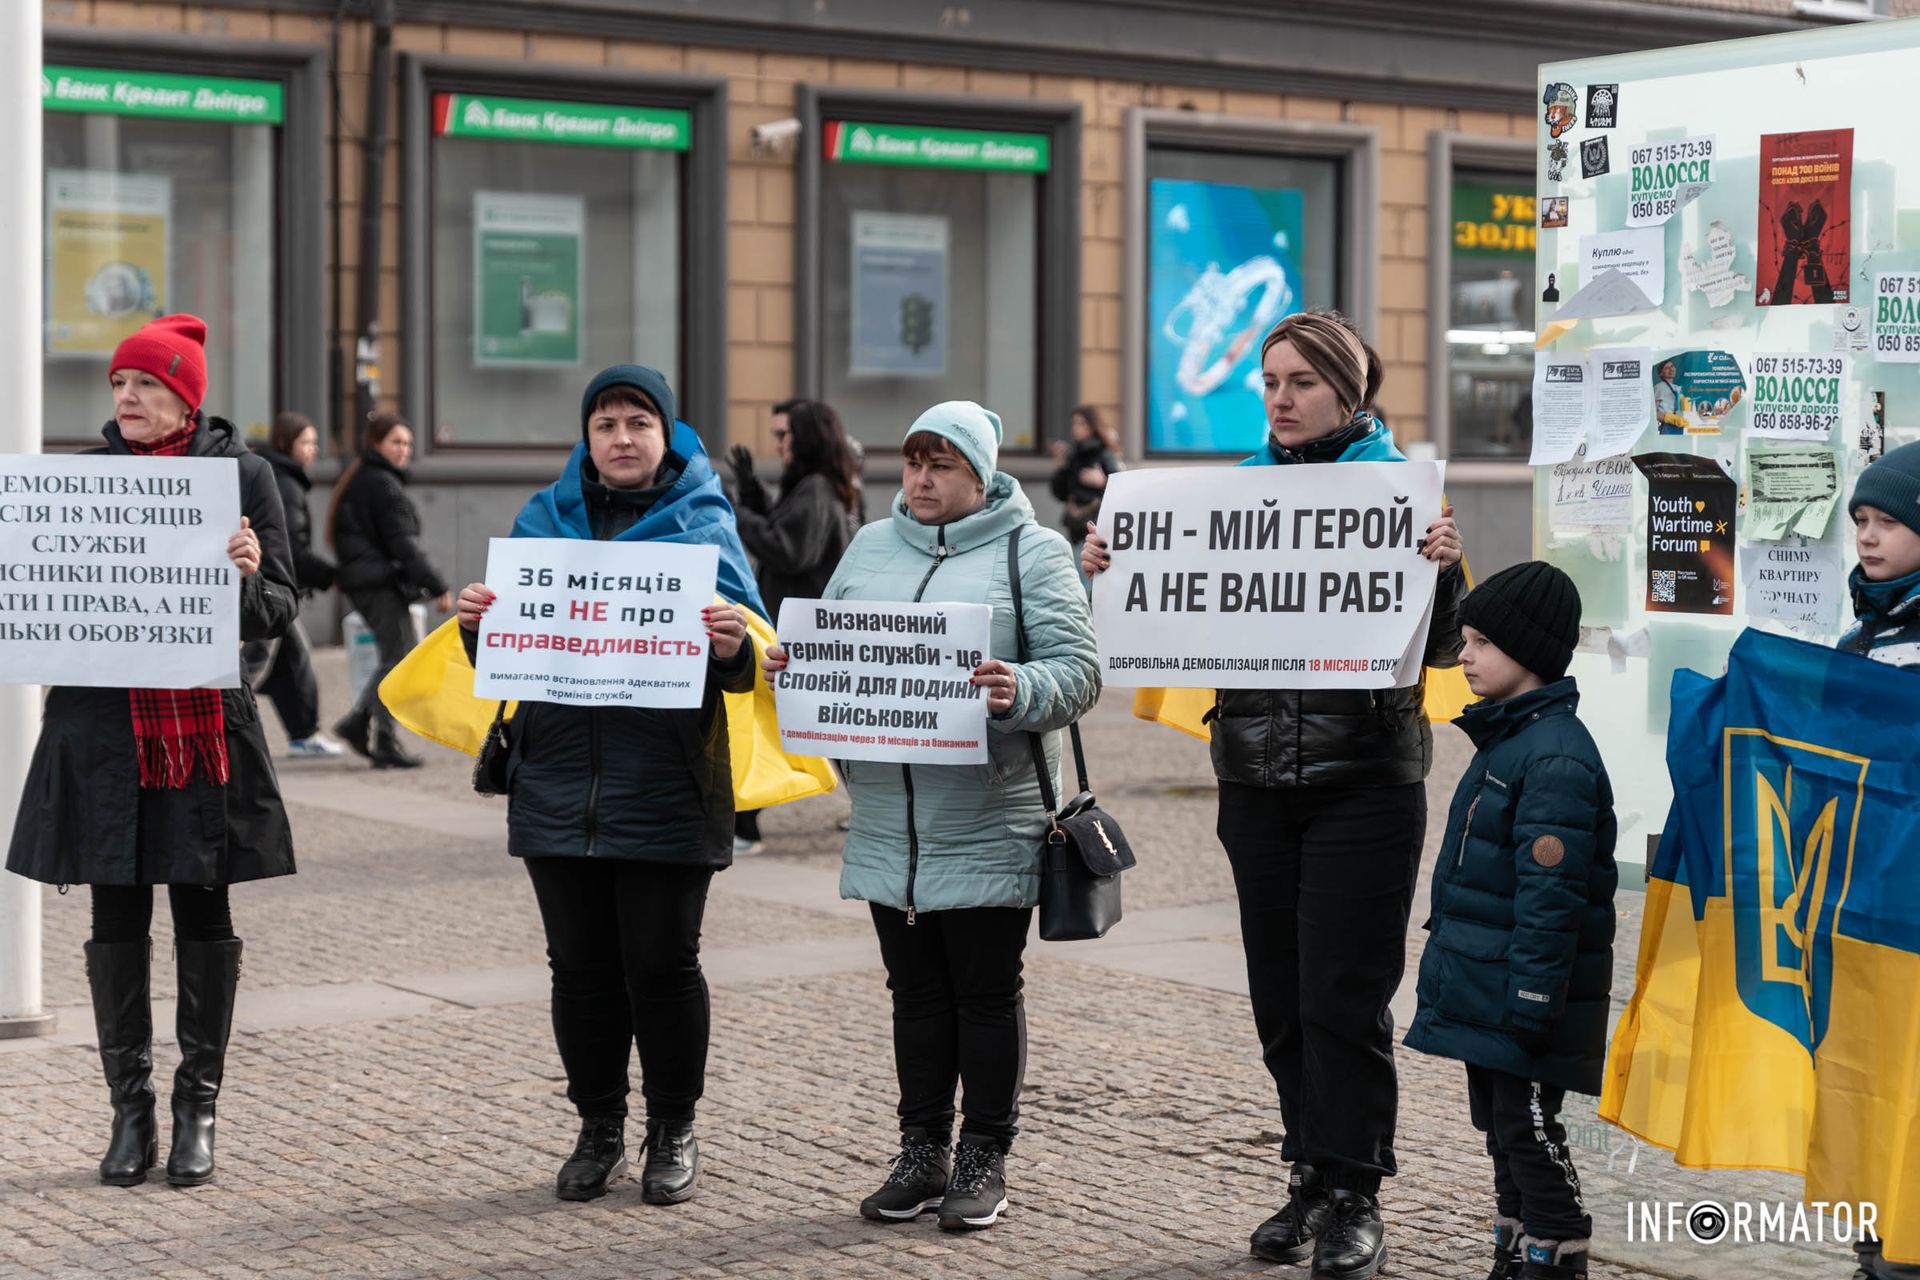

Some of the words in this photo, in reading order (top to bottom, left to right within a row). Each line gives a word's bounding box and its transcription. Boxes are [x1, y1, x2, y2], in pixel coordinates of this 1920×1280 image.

[55, 76, 109, 101] Банк
[113, 81, 192, 107] Кредит
[1632, 148, 1652, 165] 067
[1656, 140, 1712, 162] 515-73-39
[1632, 159, 1710, 192] ВОЛОССЯ
[1771, 165, 1798, 177] ПОНАД
[1814, 161, 1840, 174] ВОЇНІВ
[1631, 190, 1672, 204] купуємо
[1632, 201, 1653, 218] 050
[1592, 248, 1621, 260] Куплю
[1880, 277, 1903, 293] 067
[1878, 334, 1901, 351] 050
[1756, 357, 1778, 373] 067
[1782, 358, 1843, 374] 515-73-39
[1754, 375, 1840, 404] ВОЛОССЯ
[1753, 403, 1797, 415] купуємо
[1801, 404, 1838, 416] дорого
[1754, 413, 1776, 429] 050
[0, 475, 192, 498] ЕМОБІЛІЗАЦІЯ
[1652, 496, 1693, 514] Youth
[61, 505, 83, 524] 18
[90, 506, 202, 529] МІСЯЦІВ
[1113, 510, 1173, 551] ВІН
[1183, 528, 1197, 537] -
[1209, 499, 1280, 551] МІЙ
[1292, 496, 1425, 555] ГЕРОЙ,
[1652, 516, 1713, 533] Wartime
[31, 534, 146, 555] СЛУЖБИ
[1652, 534, 1698, 552] Forum
[1768, 550, 1812, 563] СНИМУ
[111, 565, 230, 586] ПОВИННІ
[518, 567, 553, 587] 36
[567, 571, 681, 594] місяців
[1760, 569, 1821, 582] КВАРТИРУ
[1125, 572, 1148, 612] А
[1160, 572, 1209, 612] НЕ
[1219, 572, 1306, 613] ВАШ
[1319, 571, 1404, 613] РАБ!
[0, 592, 38, 612] ТИ
[47, 593, 54, 612] І
[62, 593, 149, 616] ПРАВА,
[155, 596, 172, 614] А
[180, 596, 213, 615] НЕ
[519, 602, 555, 621] це
[569, 600, 609, 622] НЕ
[621, 606, 674, 627] про
[815, 607, 947, 635] Визначений
[486, 631, 701, 657] справедливість
[781, 640, 854, 663] термін
[859, 642, 941, 666] служби
[957, 649, 983, 671] це
[1109, 656, 1180, 670] ДОБРОВІЛЬНА
[1182, 657, 1269, 672] ДЕМОБІЛІЗАЦІЯ
[1272, 658, 1306, 671] ПІСЛЯ
[1308, 659, 1320, 672] 18
[1323, 659, 1369, 672] МІСЯЦІВ
[490, 671, 550, 682] вимагаємо
[552, 675, 625, 687] встановлення
[627, 678, 691, 689] адекватних
[778, 670, 851, 694] спокій
[856, 675, 896, 697] для
[901, 677, 982, 701] родини
[546, 688, 592, 700] термінів
[594, 691, 633, 702] служби
[818, 703, 939, 730] військових
[786, 730, 848, 743] демобілізацію
[850, 735, 876, 744] через
[877, 735, 887, 745] 18
[888, 736, 919, 747] місяців
[920, 739, 930, 748] за
[932, 738, 979, 749] бажанням
